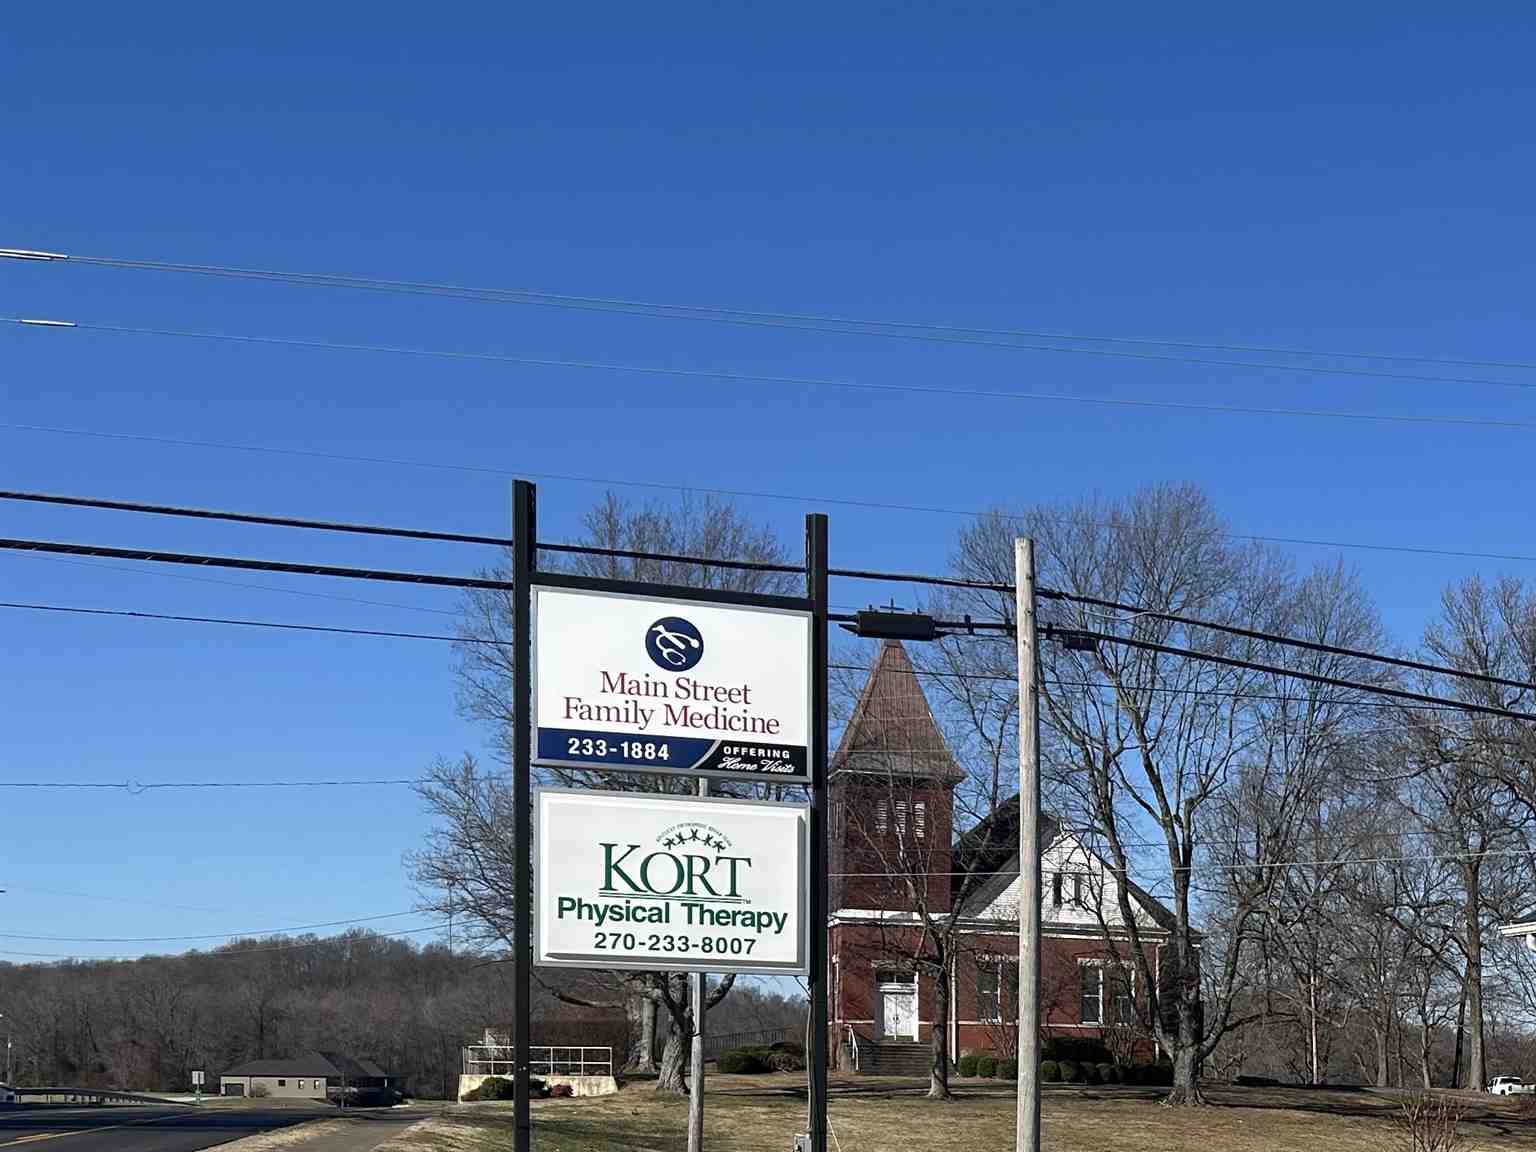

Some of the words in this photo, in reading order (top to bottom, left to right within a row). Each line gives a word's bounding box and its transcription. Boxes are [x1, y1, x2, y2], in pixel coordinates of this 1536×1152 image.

[600, 671, 669, 698] Main
[674, 677, 752, 705] Street
[563, 697, 655, 730] Family
[663, 704, 780, 735] Medicine
[567, 737, 670, 761] 233-1884
[723, 746, 790, 759] OFFERING
[717, 756, 758, 771] Home
[758, 759, 795, 774] Visits
[599, 843, 752, 898] KORT
[557, 896, 670, 927] Physical
[680, 902, 788, 935] Therapy
[594, 932, 757, 955] 270-233-8007
